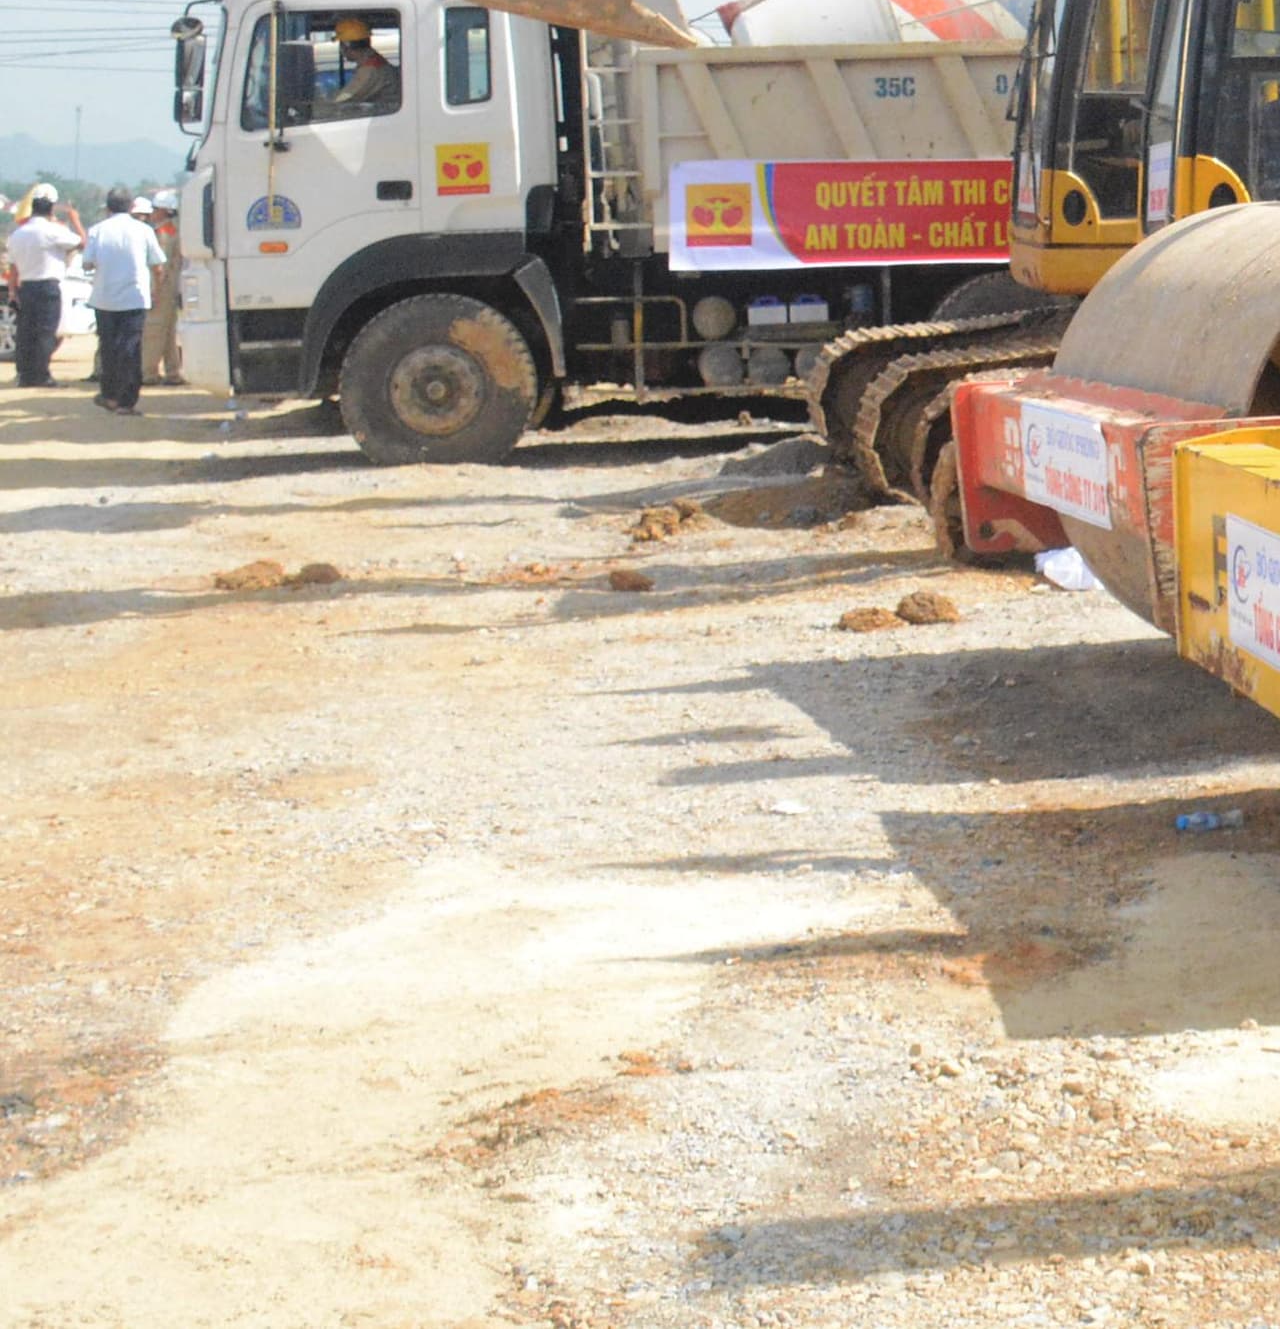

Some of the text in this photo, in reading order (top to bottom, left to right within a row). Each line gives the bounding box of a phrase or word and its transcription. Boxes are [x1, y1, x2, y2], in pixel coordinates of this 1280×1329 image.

[874, 76, 916, 99] 35C
[815, 172, 888, 209] QUYẾT
[895, 178, 944, 207] TÂM
[951, 179, 986, 206] THI
[993, 179, 1012, 205] C
[805, 223, 838, 251] AN
[845, 216, 905, 249] TOÀN
[929, 211, 986, 248] CHẤT
